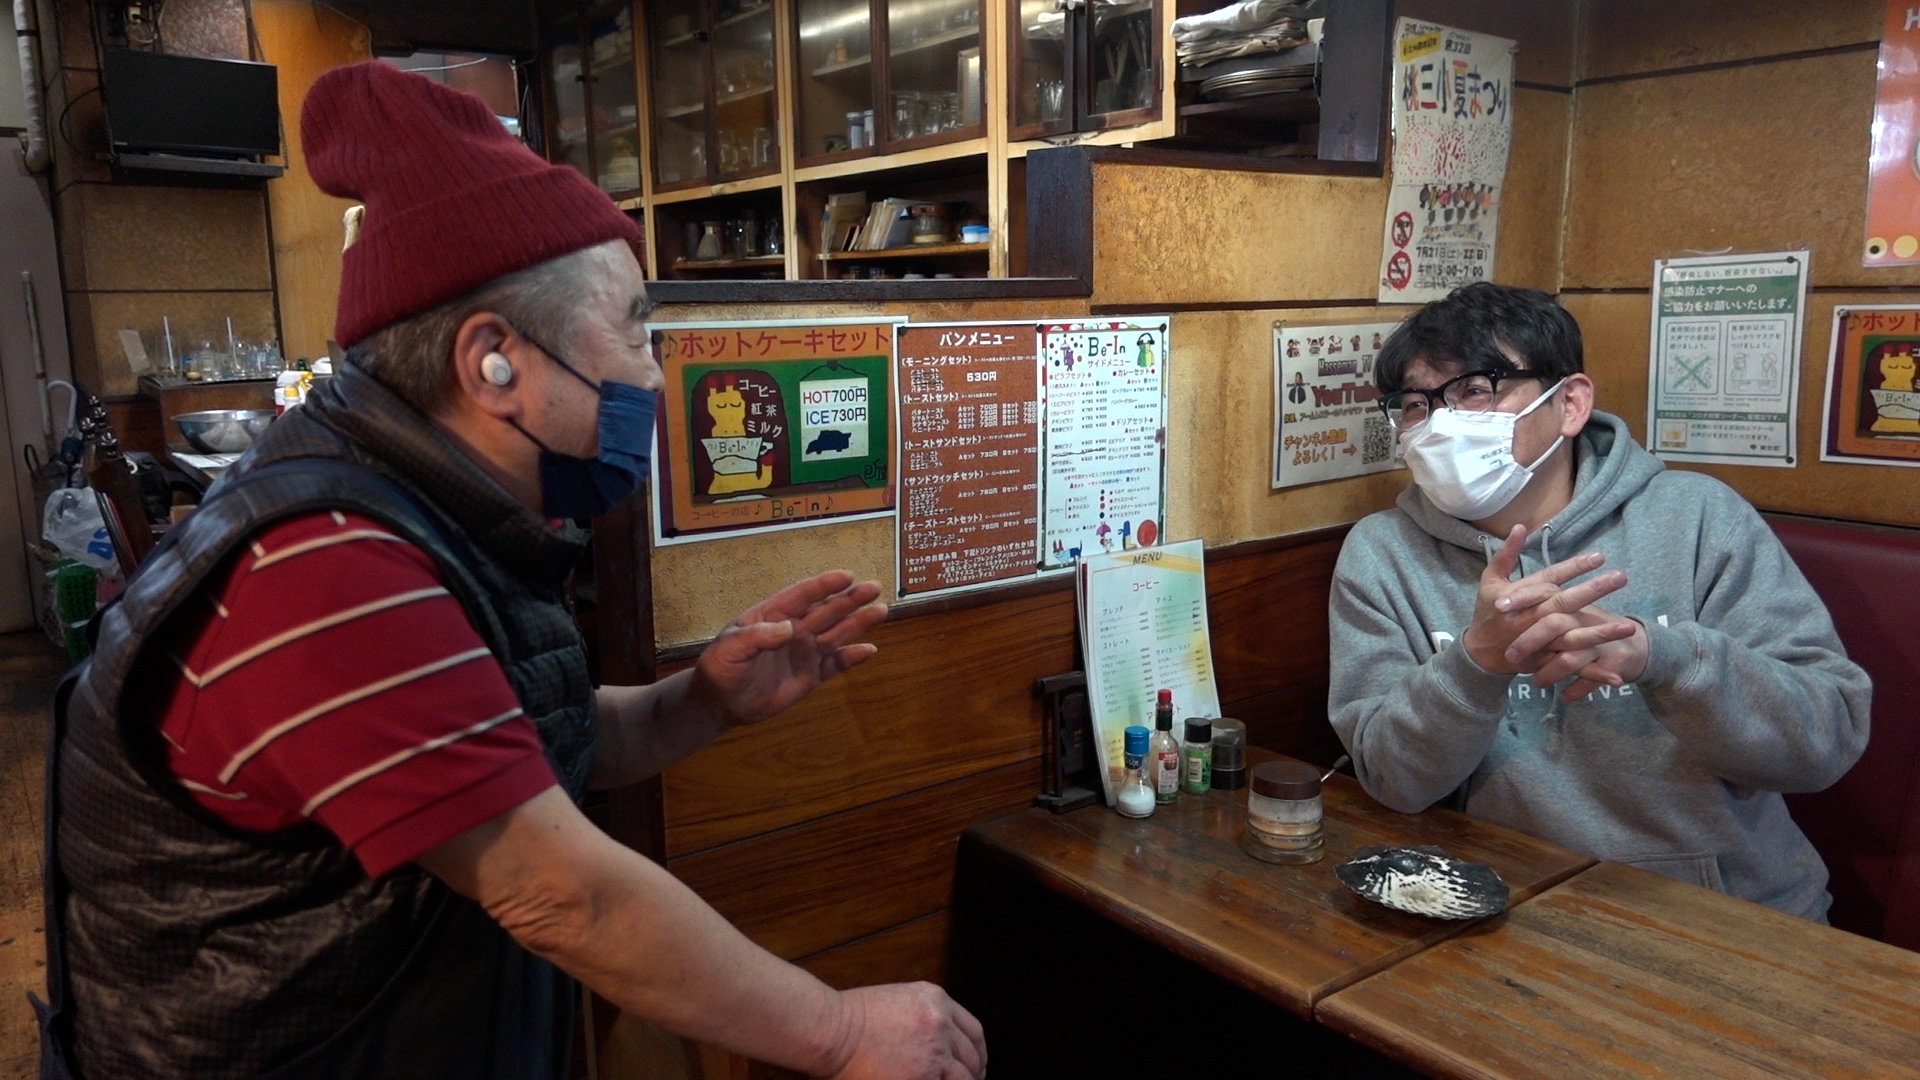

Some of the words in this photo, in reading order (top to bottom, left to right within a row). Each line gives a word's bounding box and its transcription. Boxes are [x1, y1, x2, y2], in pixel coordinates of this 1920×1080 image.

[1663, 284, 1758, 297] 感染防止マナーへの
[1663, 298, 1792, 313] ご協力をお願いいたします。
[680, 327, 889, 358] ホットケーキセット
[939, 331, 1015, 346] パンメニュー
[1087, 335, 1126, 357] Be-In
[1088, 359, 1131, 368] サイドメニュー
[966, 371, 997, 382] 530円
[1053, 372, 1086, 380] ピラフセット
[1117, 368, 1150, 377] カレーセット
[739, 379, 776, 398] コーヒー
[746, 420, 783, 438] ミルク
[692, 506, 749, 521] コーヒーの店
[771, 500, 820, 519] Be-In
[1132, 551, 1163, 565] MENU
[1132, 580, 1160, 592] コーヒー
